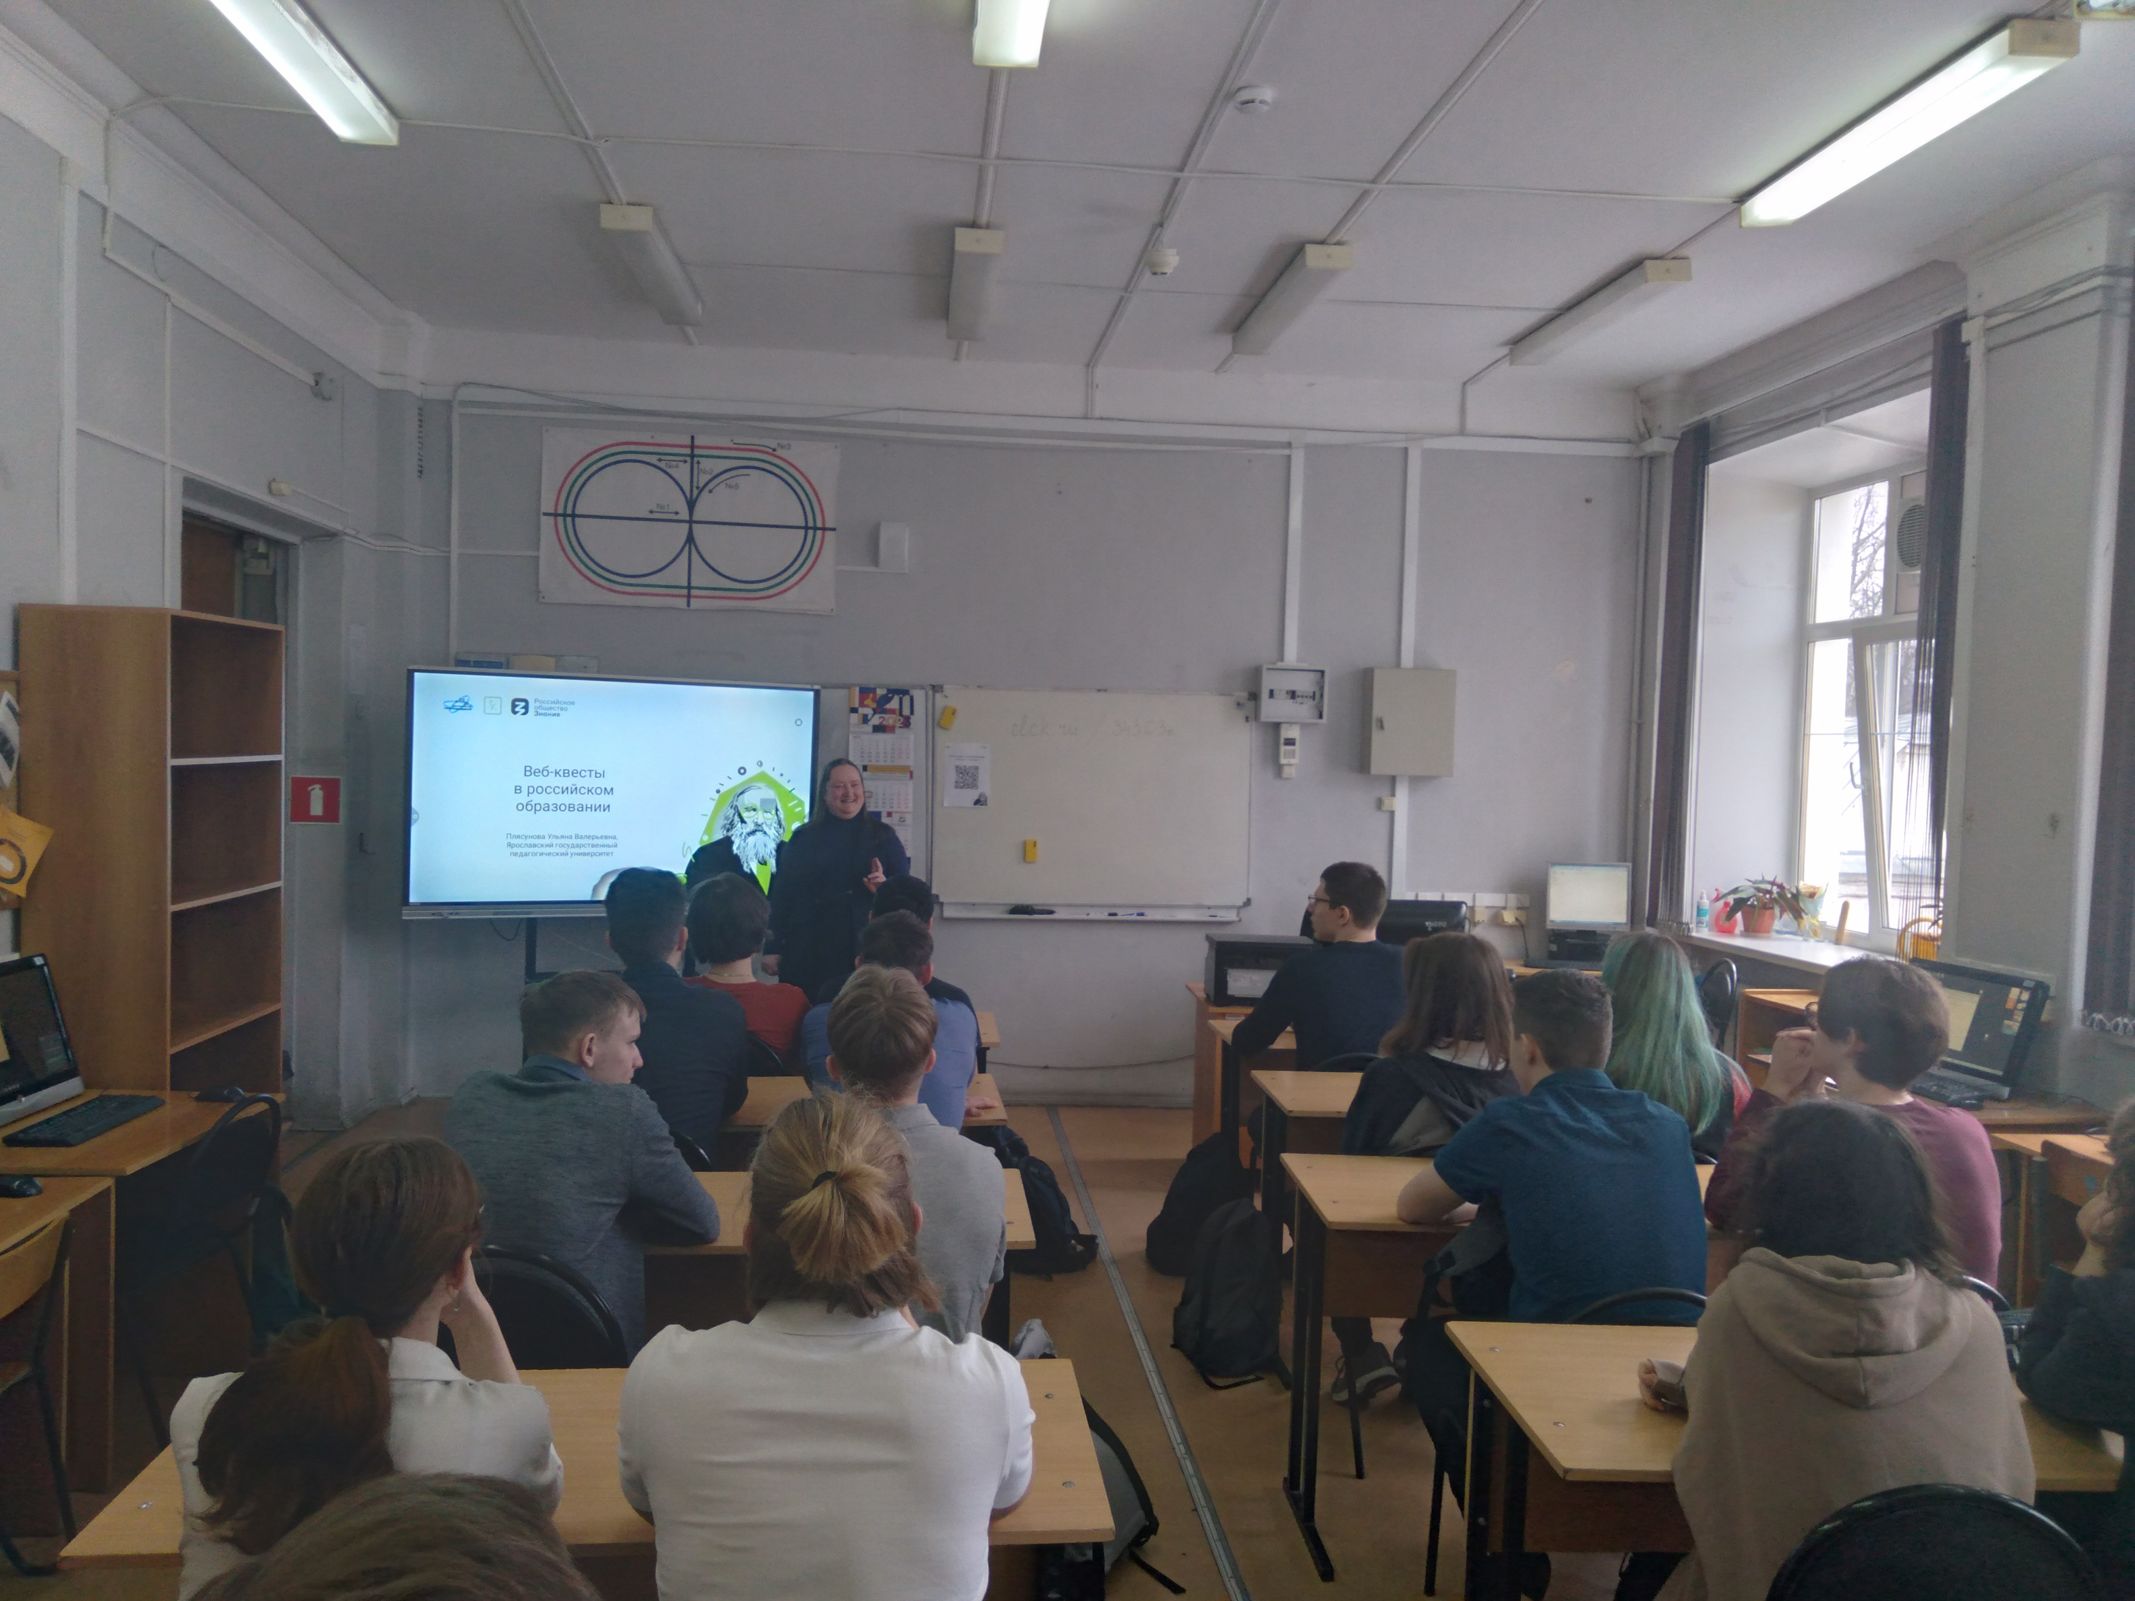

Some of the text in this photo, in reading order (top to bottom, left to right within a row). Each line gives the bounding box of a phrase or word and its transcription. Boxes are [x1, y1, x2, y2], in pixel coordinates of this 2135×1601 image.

[523, 764, 606, 779] Веб-квесты
[514, 783, 615, 798] в российском
[516, 799, 611, 815] образовании
[506, 842, 618, 851] Ярославский государственный
[570, 851, 614, 859] университет
